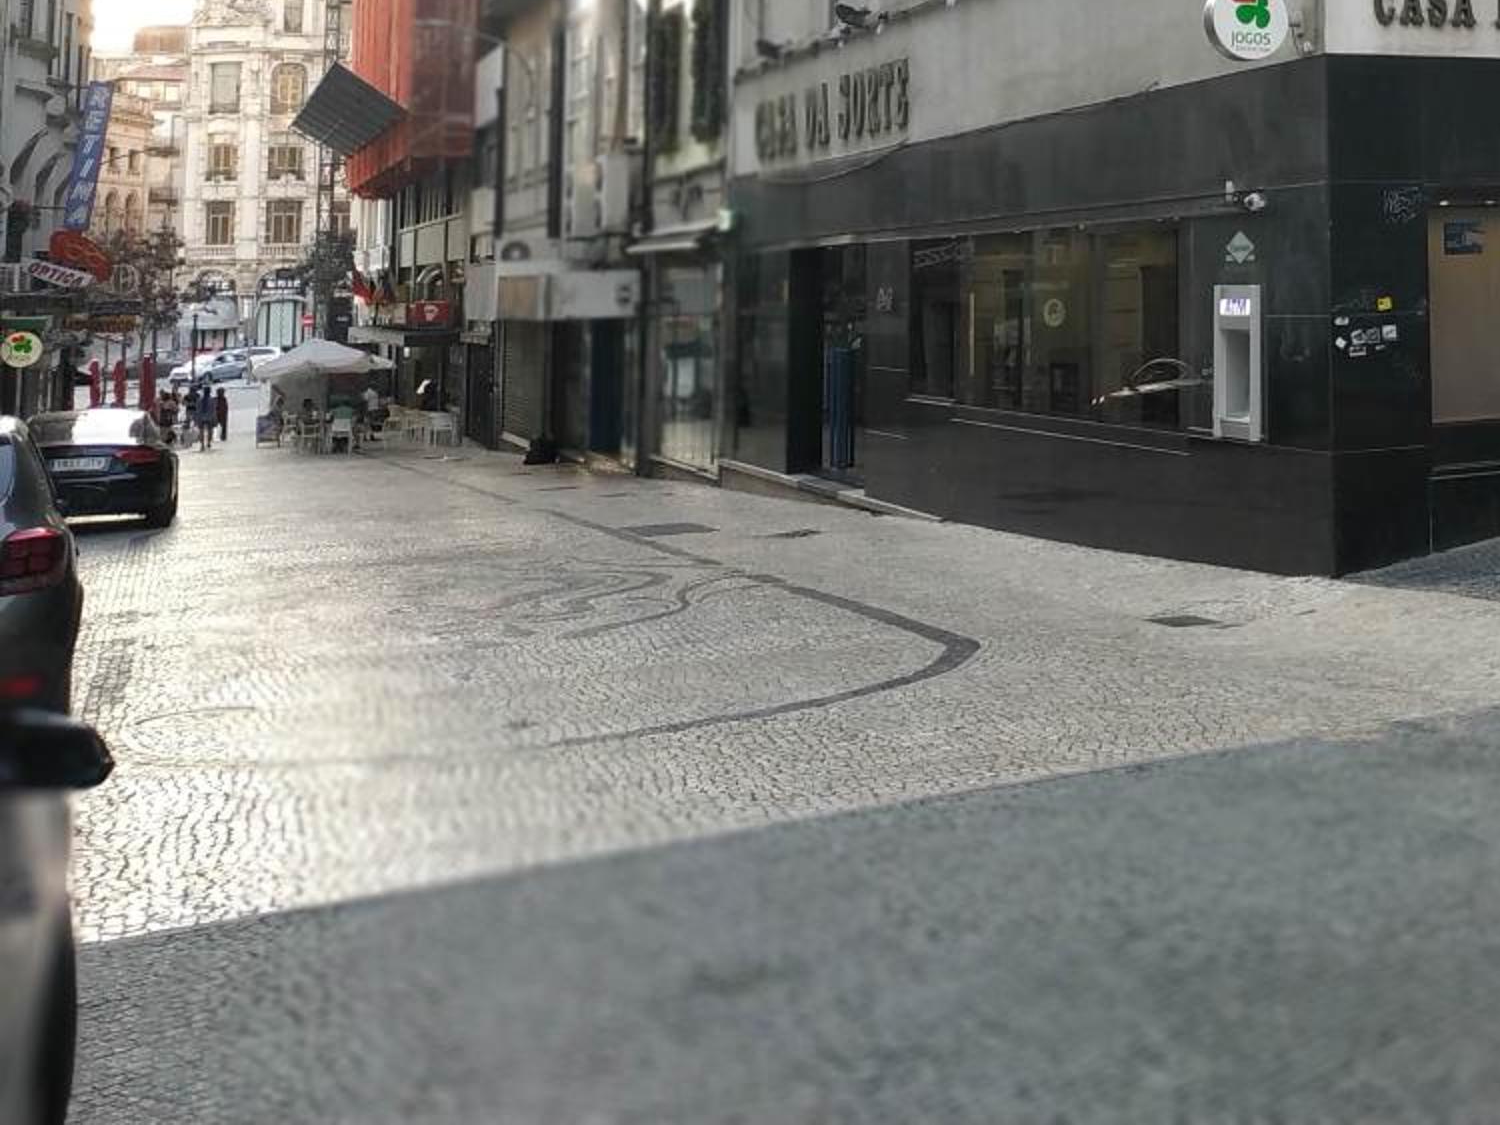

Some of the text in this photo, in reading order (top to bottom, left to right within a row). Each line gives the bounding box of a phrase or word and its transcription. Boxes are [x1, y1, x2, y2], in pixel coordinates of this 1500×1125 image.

[1231, 31, 1271, 46] JOGOS
[805, 82, 831, 150] DA
[837, 58, 909, 141] SORTE
